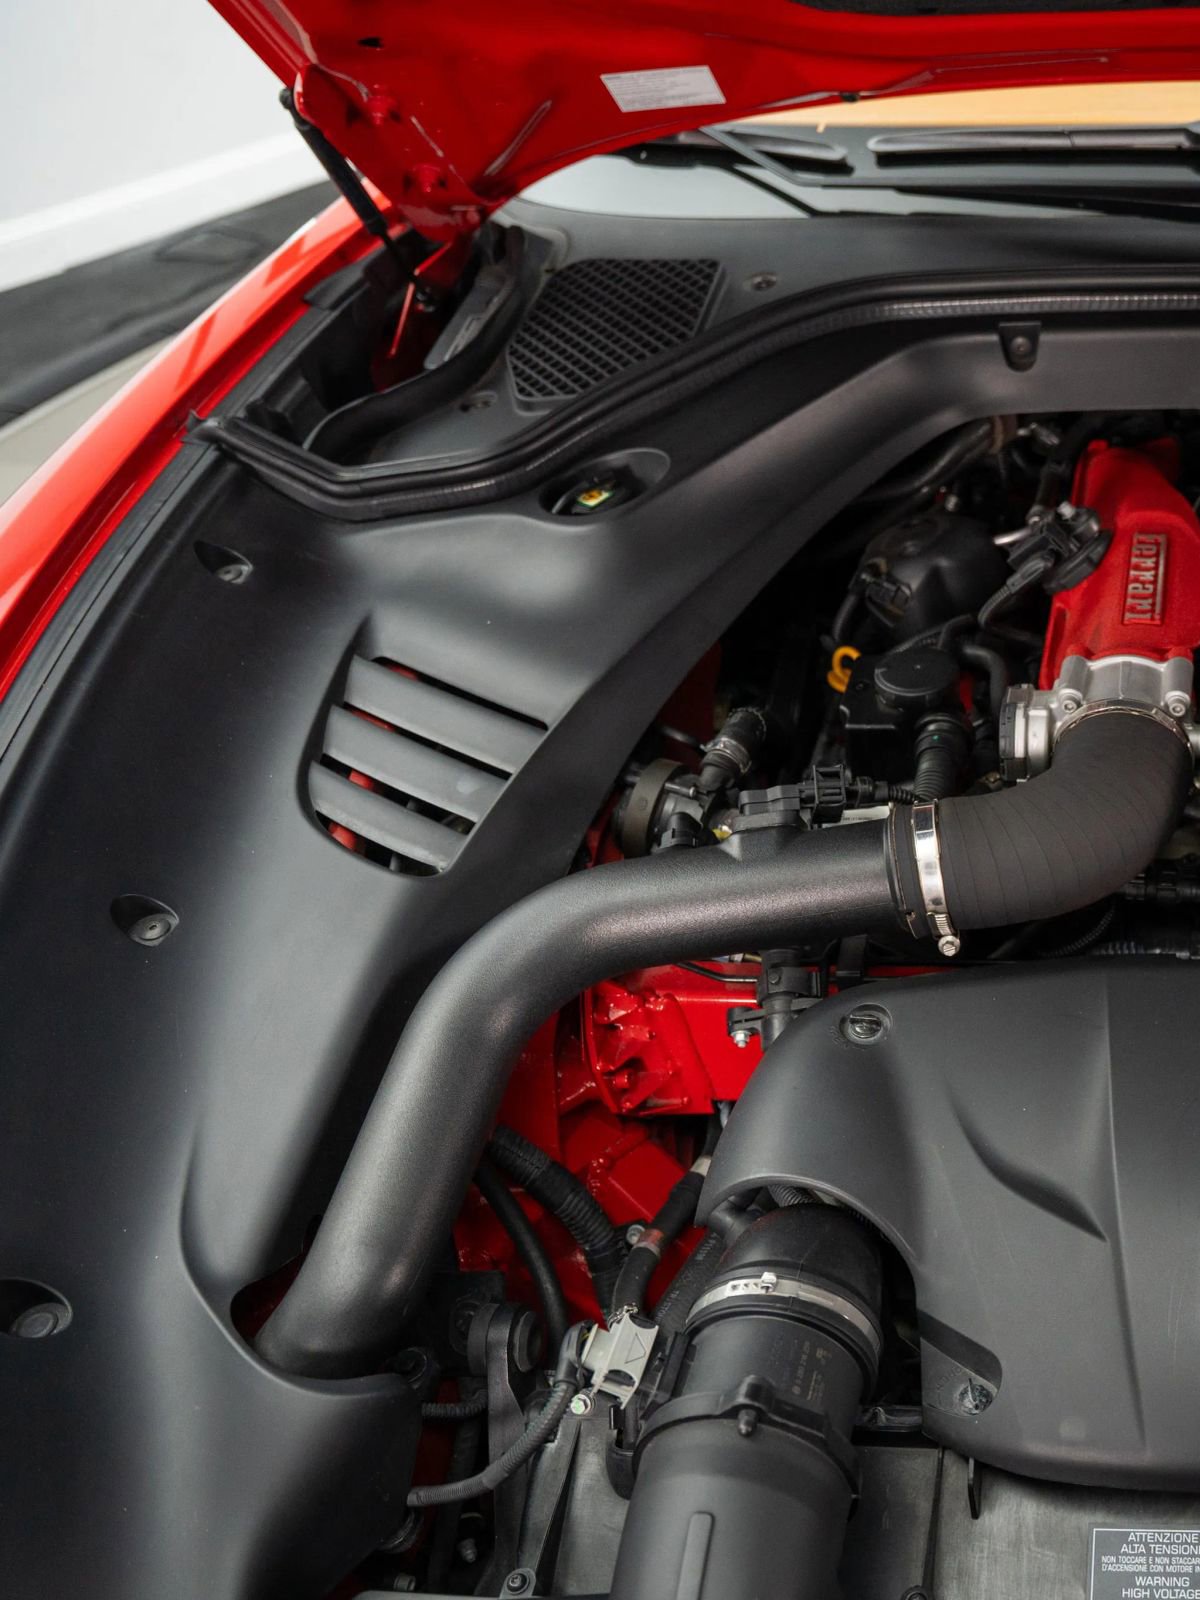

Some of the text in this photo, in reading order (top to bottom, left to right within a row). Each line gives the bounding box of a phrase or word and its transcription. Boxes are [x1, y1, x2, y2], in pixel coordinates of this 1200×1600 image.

[1124, 532, 1167, 621] Ferrari
[1128, 1532, 1199, 1543] ATTENZIONE
[1120, 1544, 1146, 1554] ALTA
[1118, 1556, 1146, 1564] TOCCARE
[1101, 1564, 1147, 1572] D'ACCENSIONE
[1166, 1565, 1193, 1573] MOTORE
[1135, 1576, 1190, 1587] WARNING
[1122, 1588, 1150, 1599] HIGH
